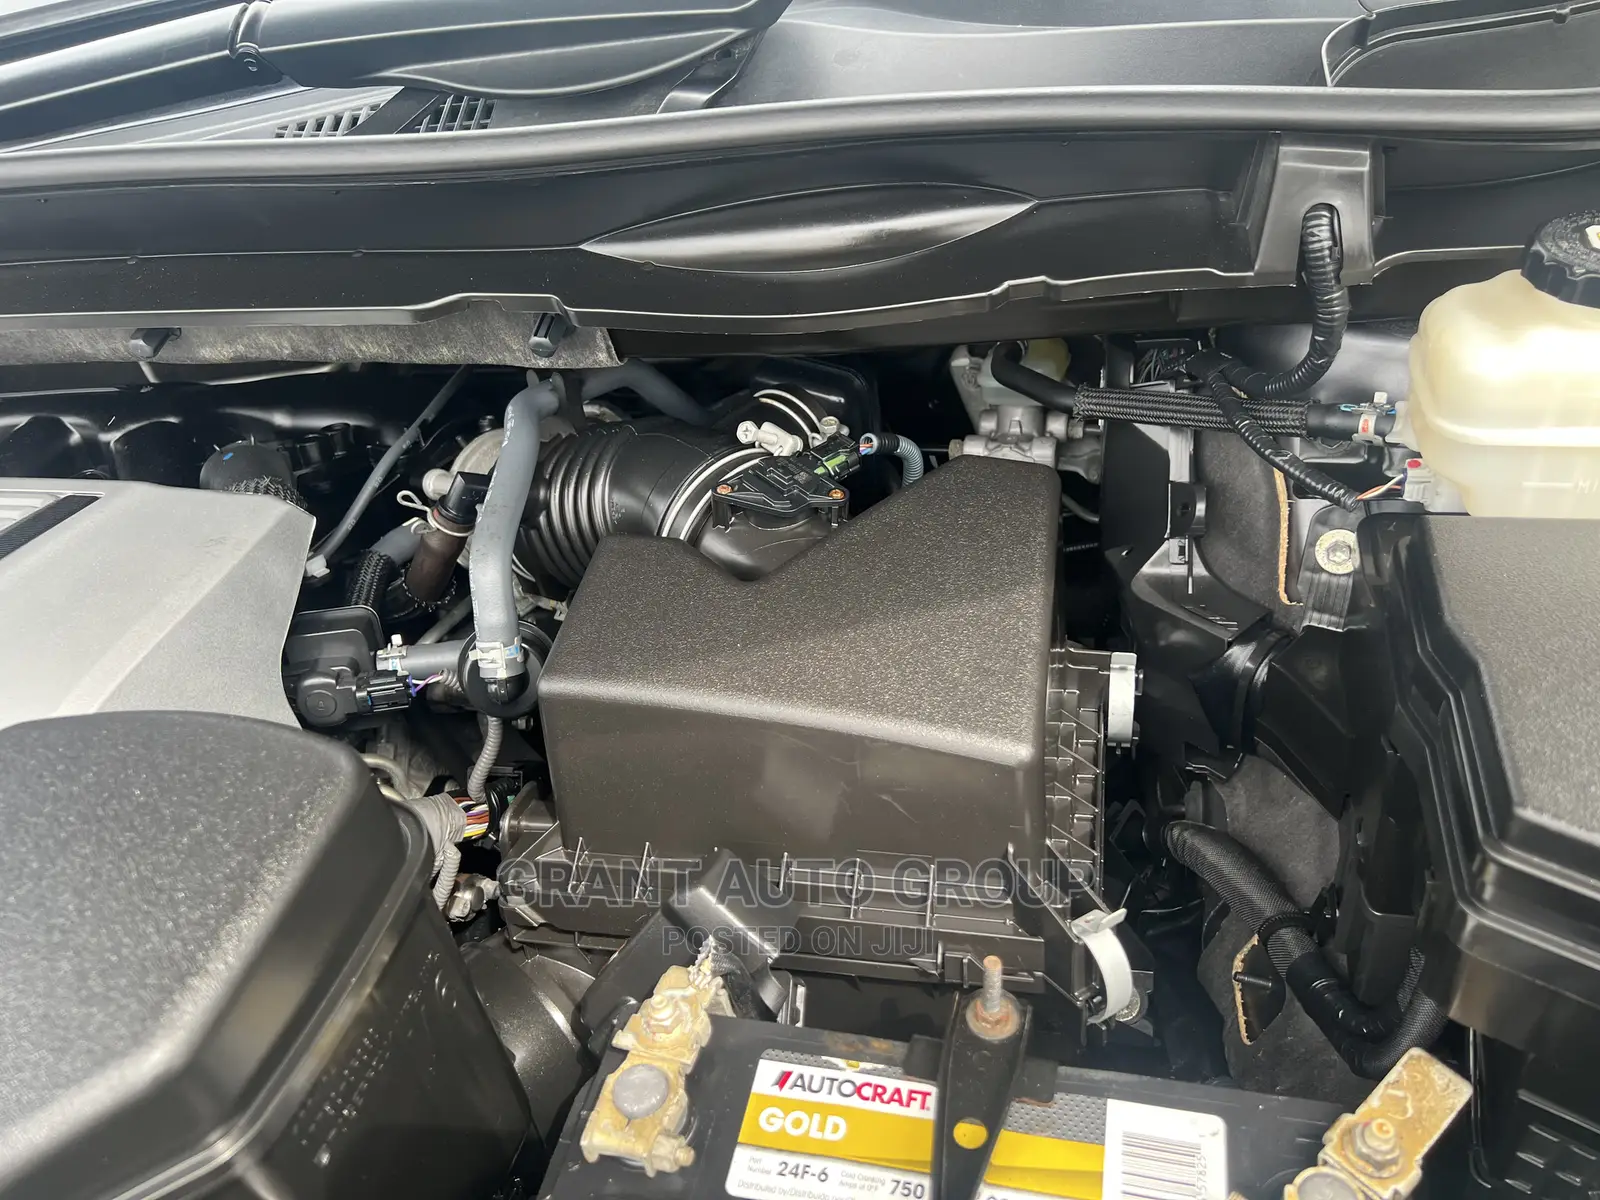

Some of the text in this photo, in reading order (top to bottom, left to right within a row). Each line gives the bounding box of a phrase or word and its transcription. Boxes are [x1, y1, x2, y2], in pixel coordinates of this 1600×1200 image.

[789, 1073, 931, 1110] AUTOCRAFT
[758, 1106, 847, 1141] GOLD
[747, 1165, 772, 1175] Number
[776, 1161, 829, 1182] 24F-6
[738, 1179, 776, 1195] Distributed
[890, 1179, 925, 1199] 750
